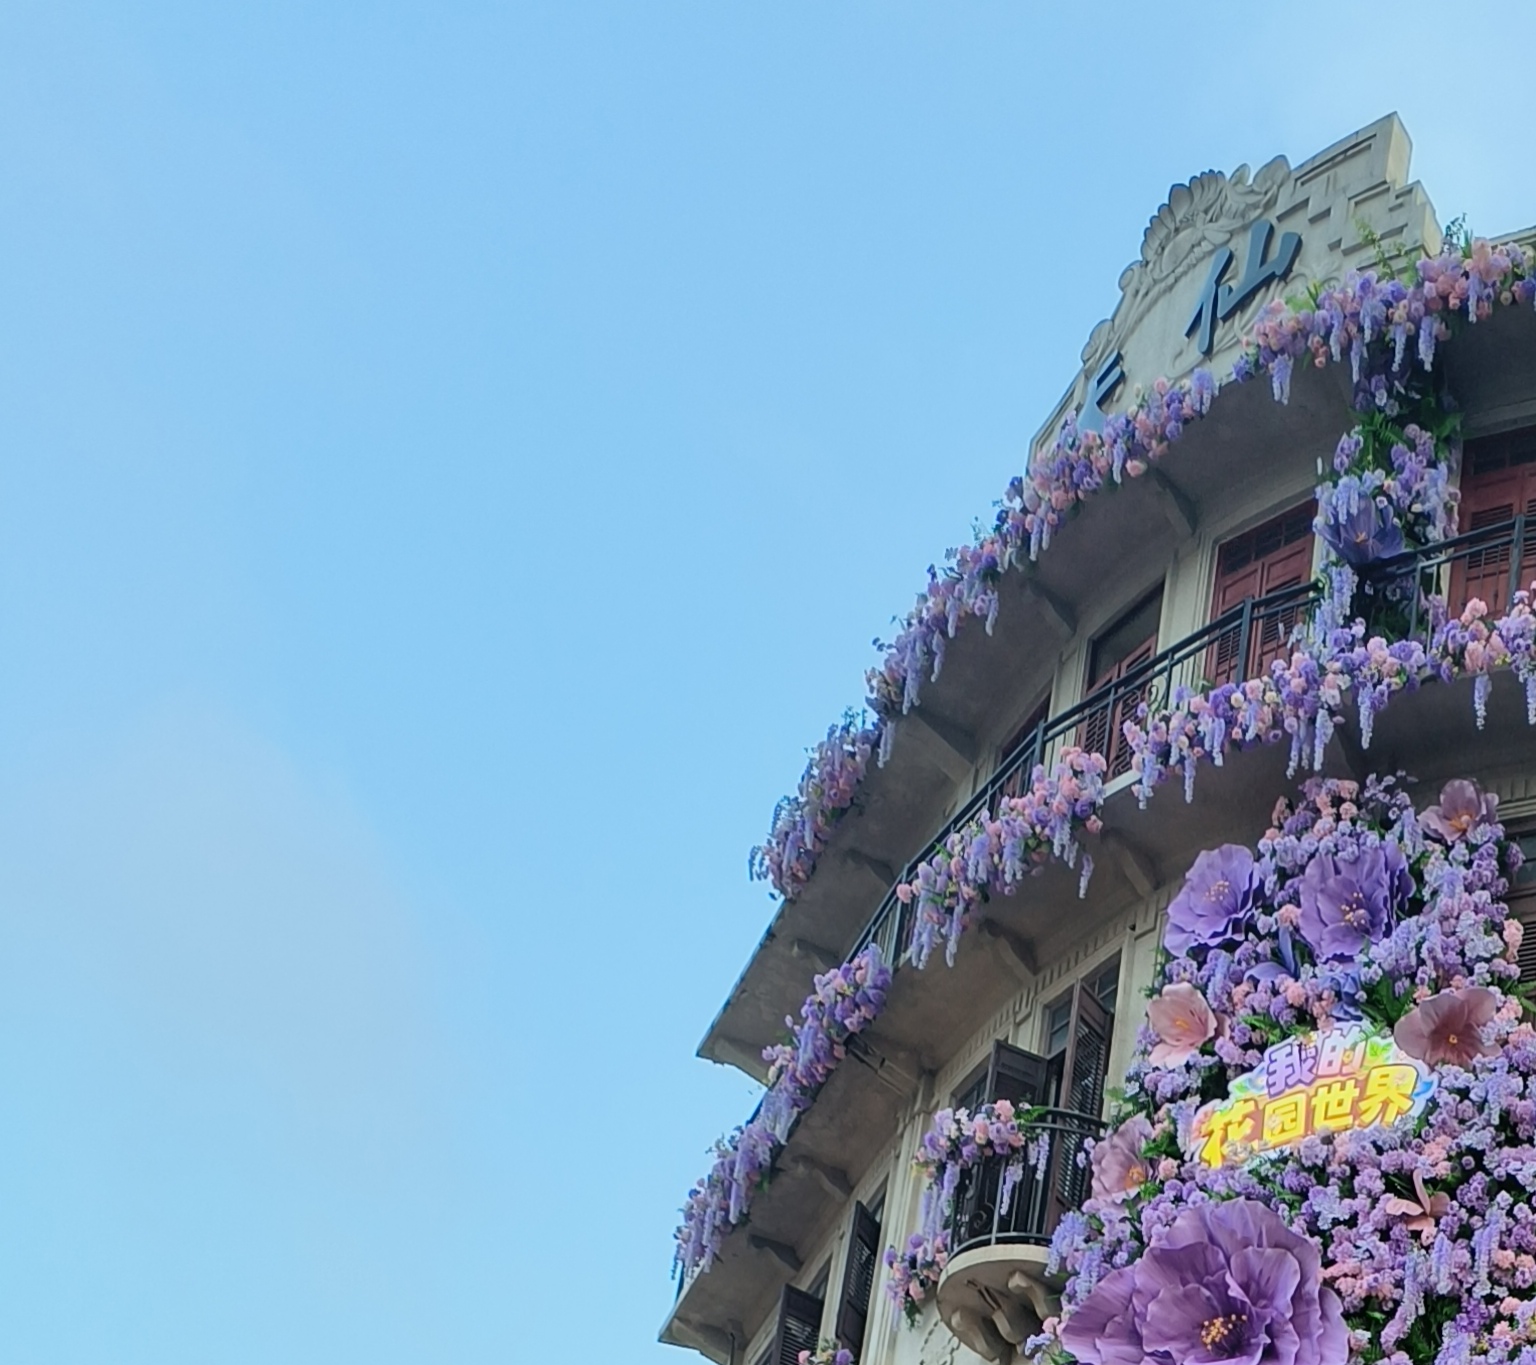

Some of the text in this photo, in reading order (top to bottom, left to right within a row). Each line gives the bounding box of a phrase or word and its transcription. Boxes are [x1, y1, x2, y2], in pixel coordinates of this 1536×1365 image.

[1266, 1030, 1368, 1098] 我的
[1200, 1064, 1418, 1168] 花园世界
